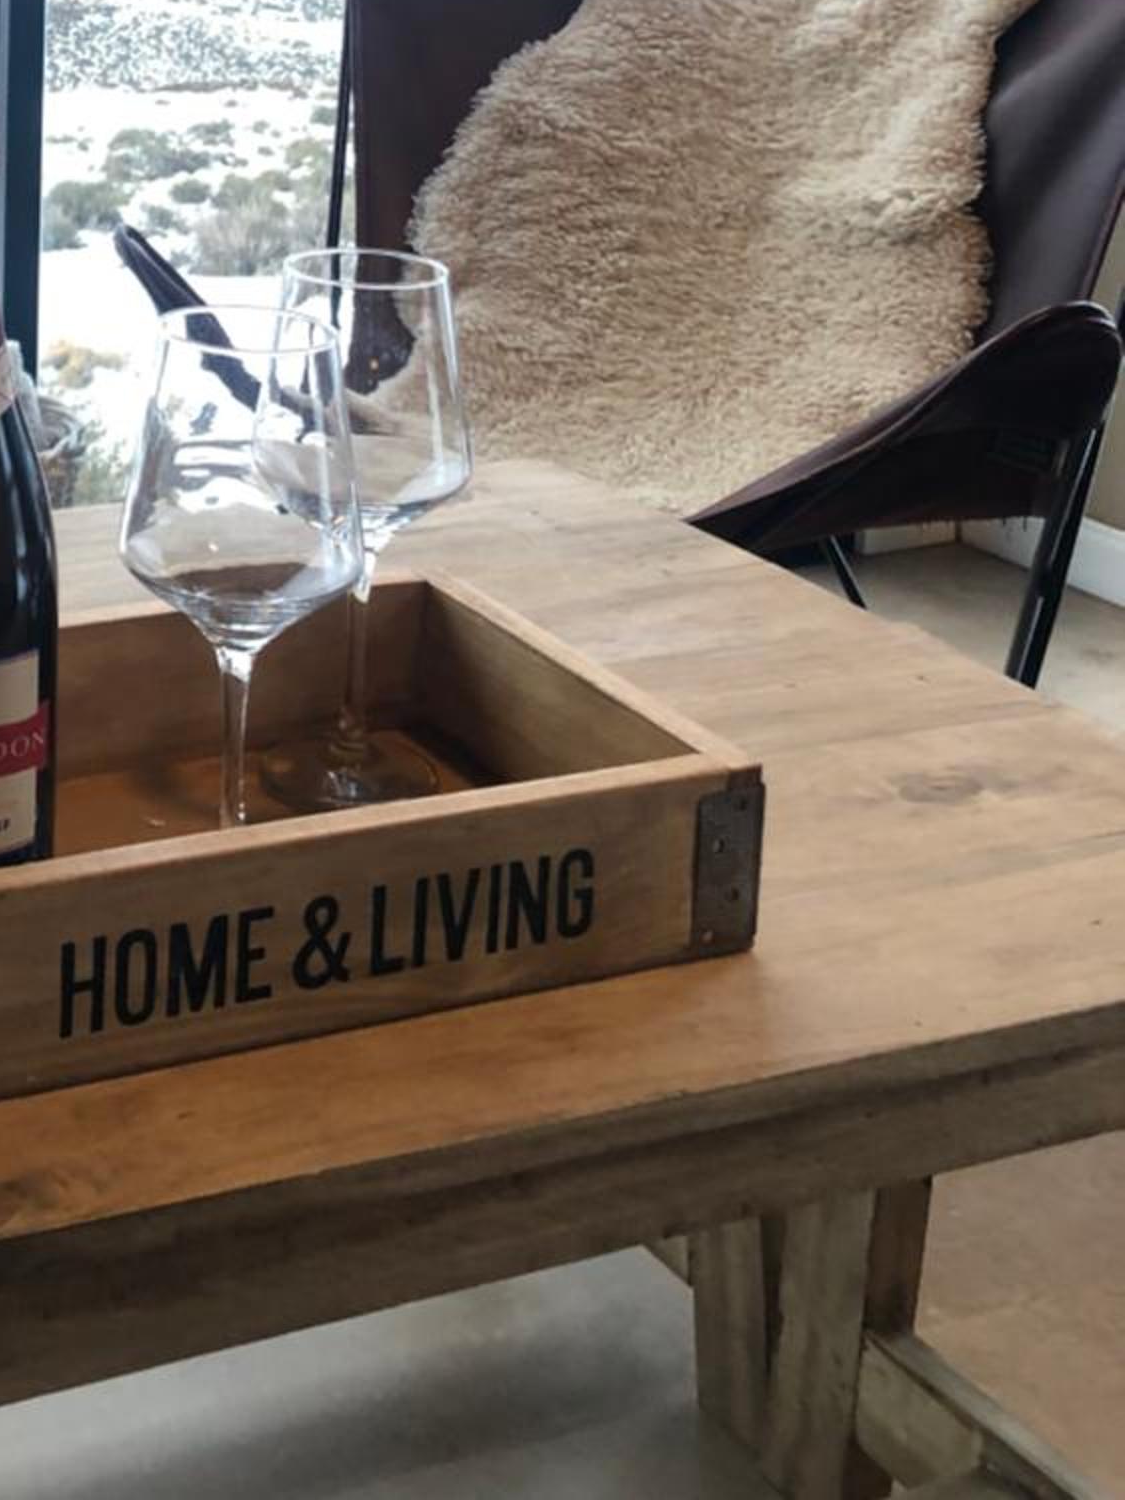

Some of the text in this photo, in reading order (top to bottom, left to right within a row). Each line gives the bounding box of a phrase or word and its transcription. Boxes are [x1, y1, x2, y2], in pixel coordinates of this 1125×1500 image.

[59, 848, 595, 1039] HOME & LIVING
